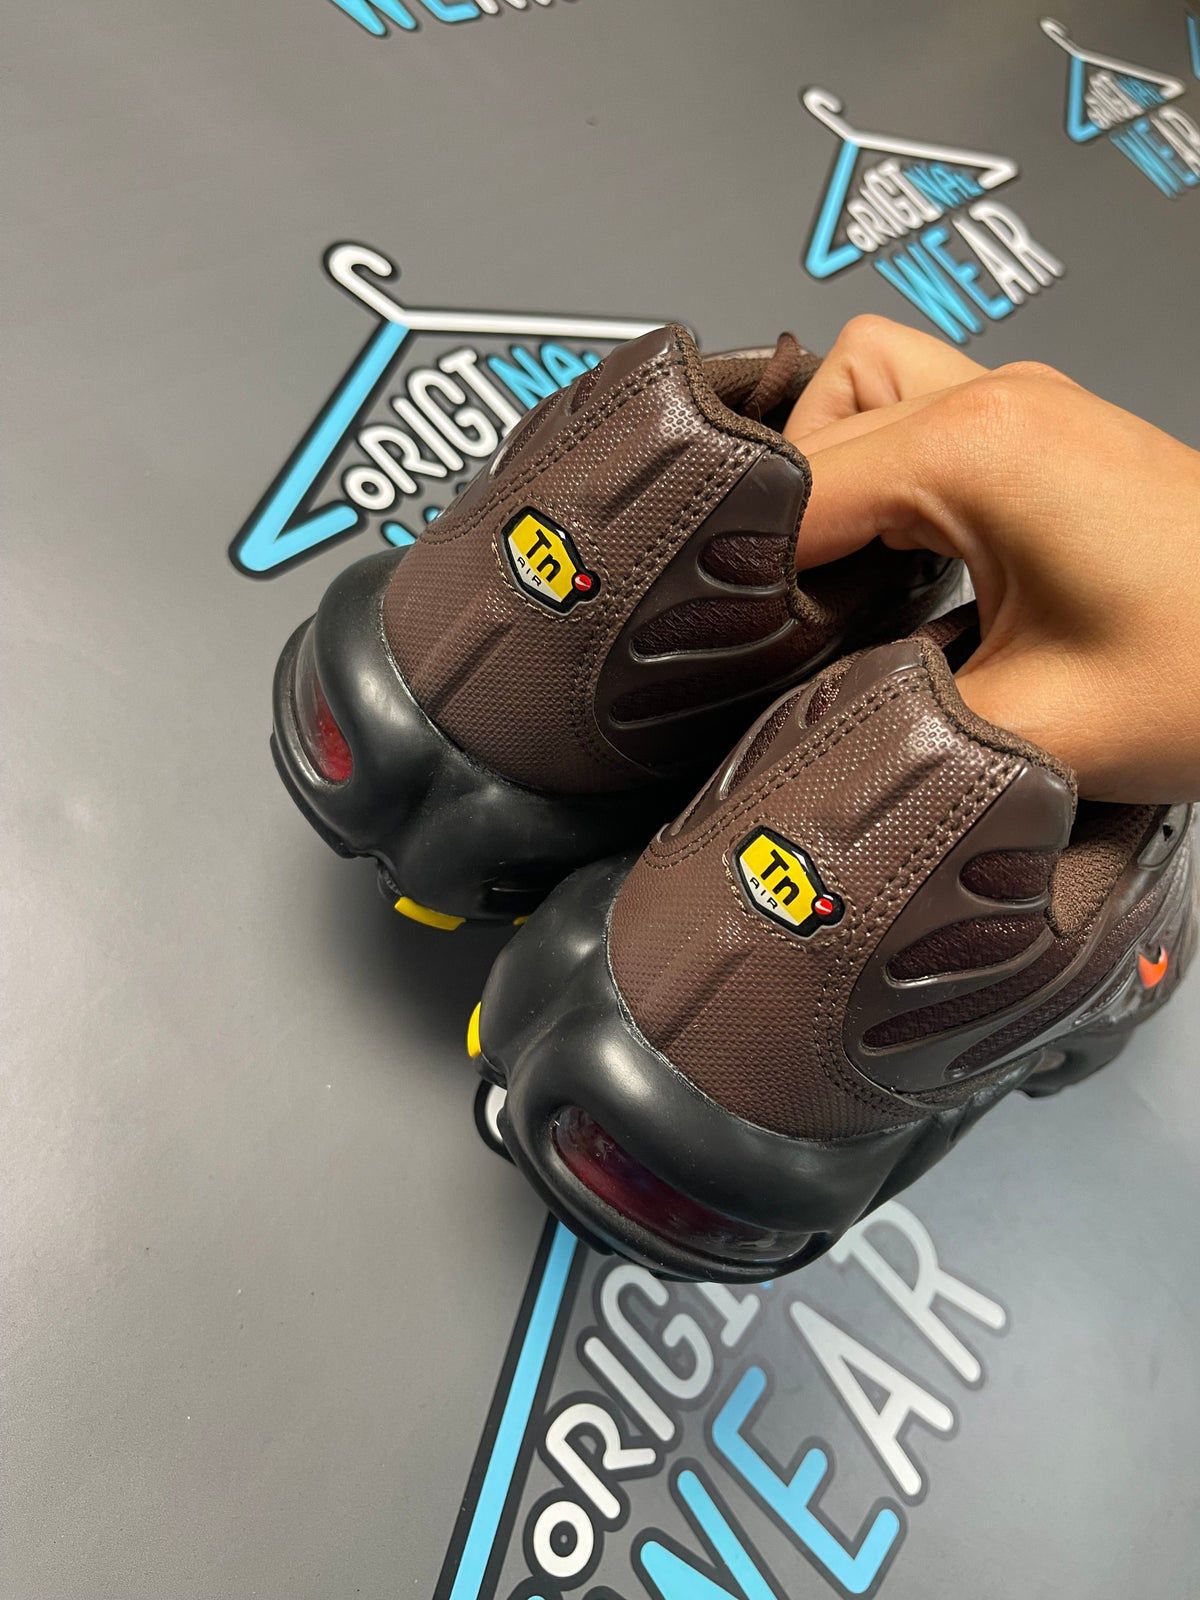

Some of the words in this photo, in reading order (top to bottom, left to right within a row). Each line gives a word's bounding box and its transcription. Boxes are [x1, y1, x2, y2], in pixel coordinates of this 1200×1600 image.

[846, 158, 985, 253] ORIGINAL
[873, 199, 1066, 344] WEAR
[343, 343, 600, 511] ORIGINA
[517, 557, 542, 587] AIR
[526, 529, 562, 583] Tn
[750, 877, 778, 909] AIR
[760, 849, 800, 906] Tn
